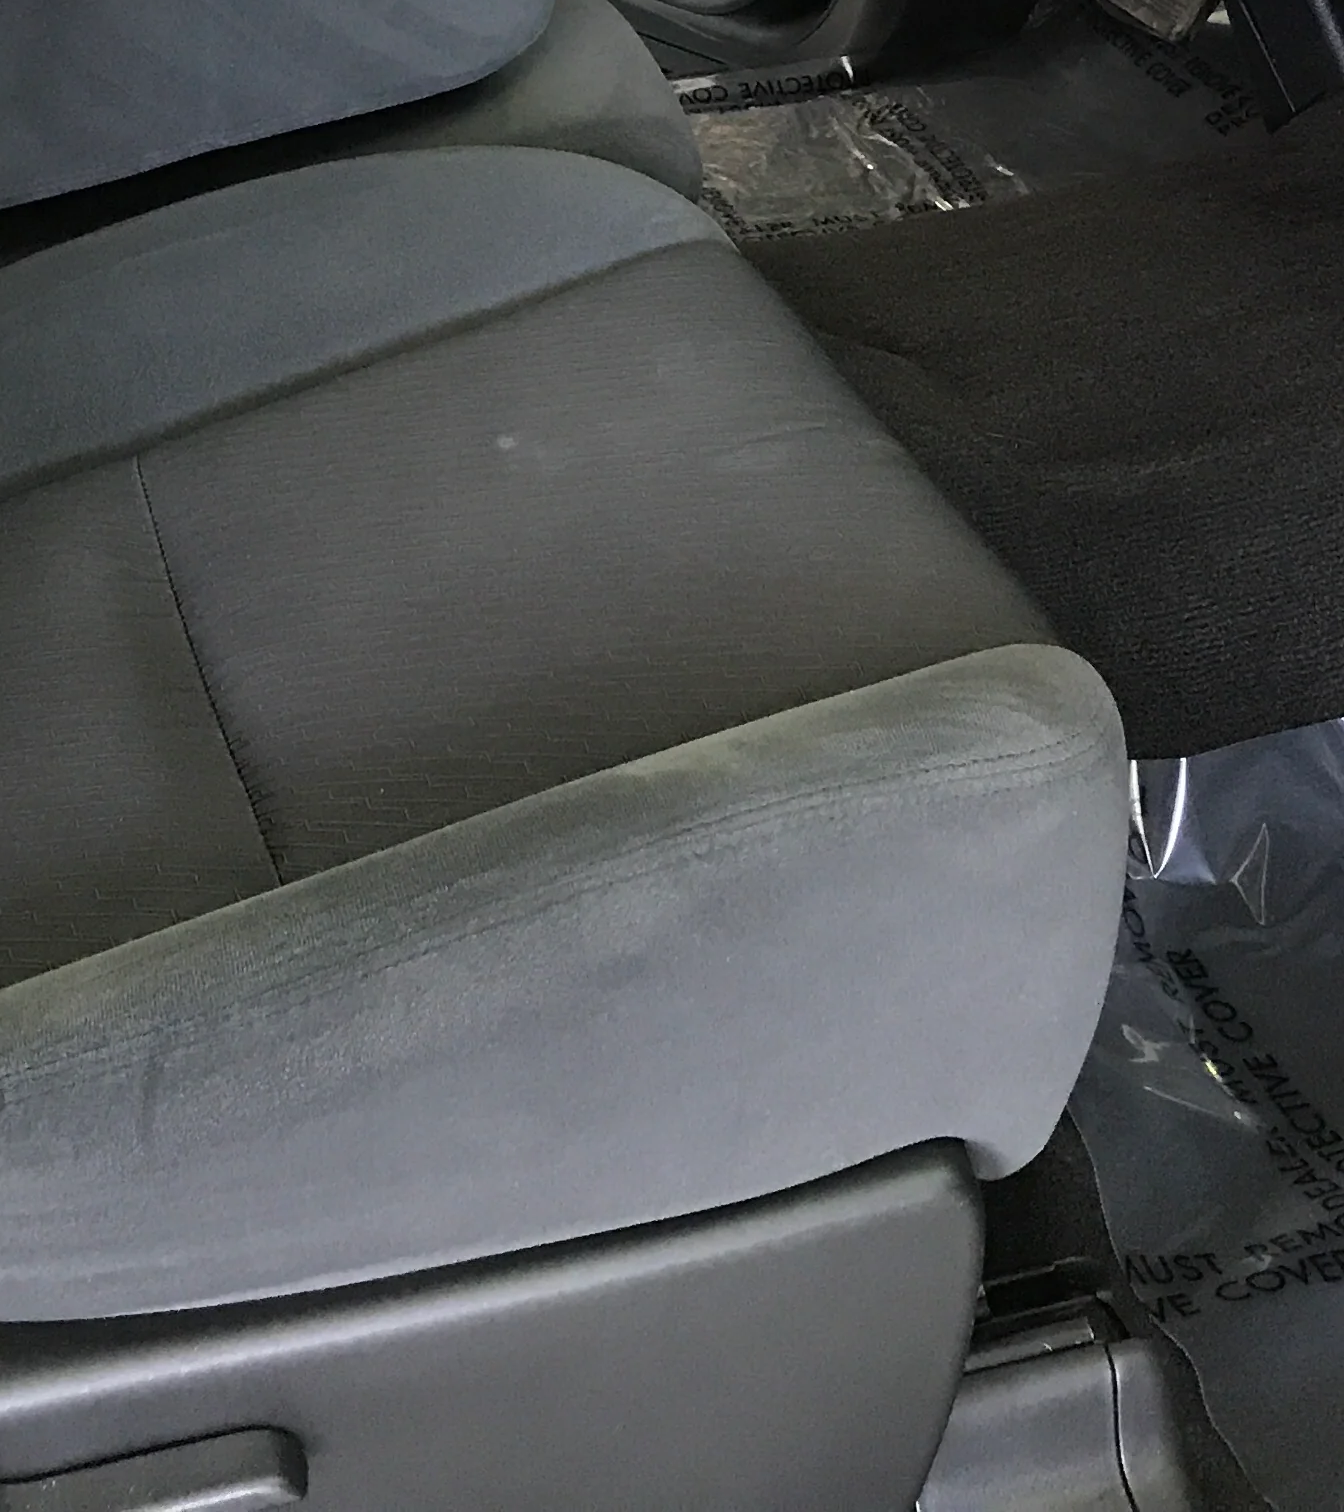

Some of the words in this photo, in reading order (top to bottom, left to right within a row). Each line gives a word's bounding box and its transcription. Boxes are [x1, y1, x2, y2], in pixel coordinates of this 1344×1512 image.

[679, 86, 729, 106] COV
[1122, 886, 1180, 1004] REMO
[1164, 947, 1253, 1045] COVER
